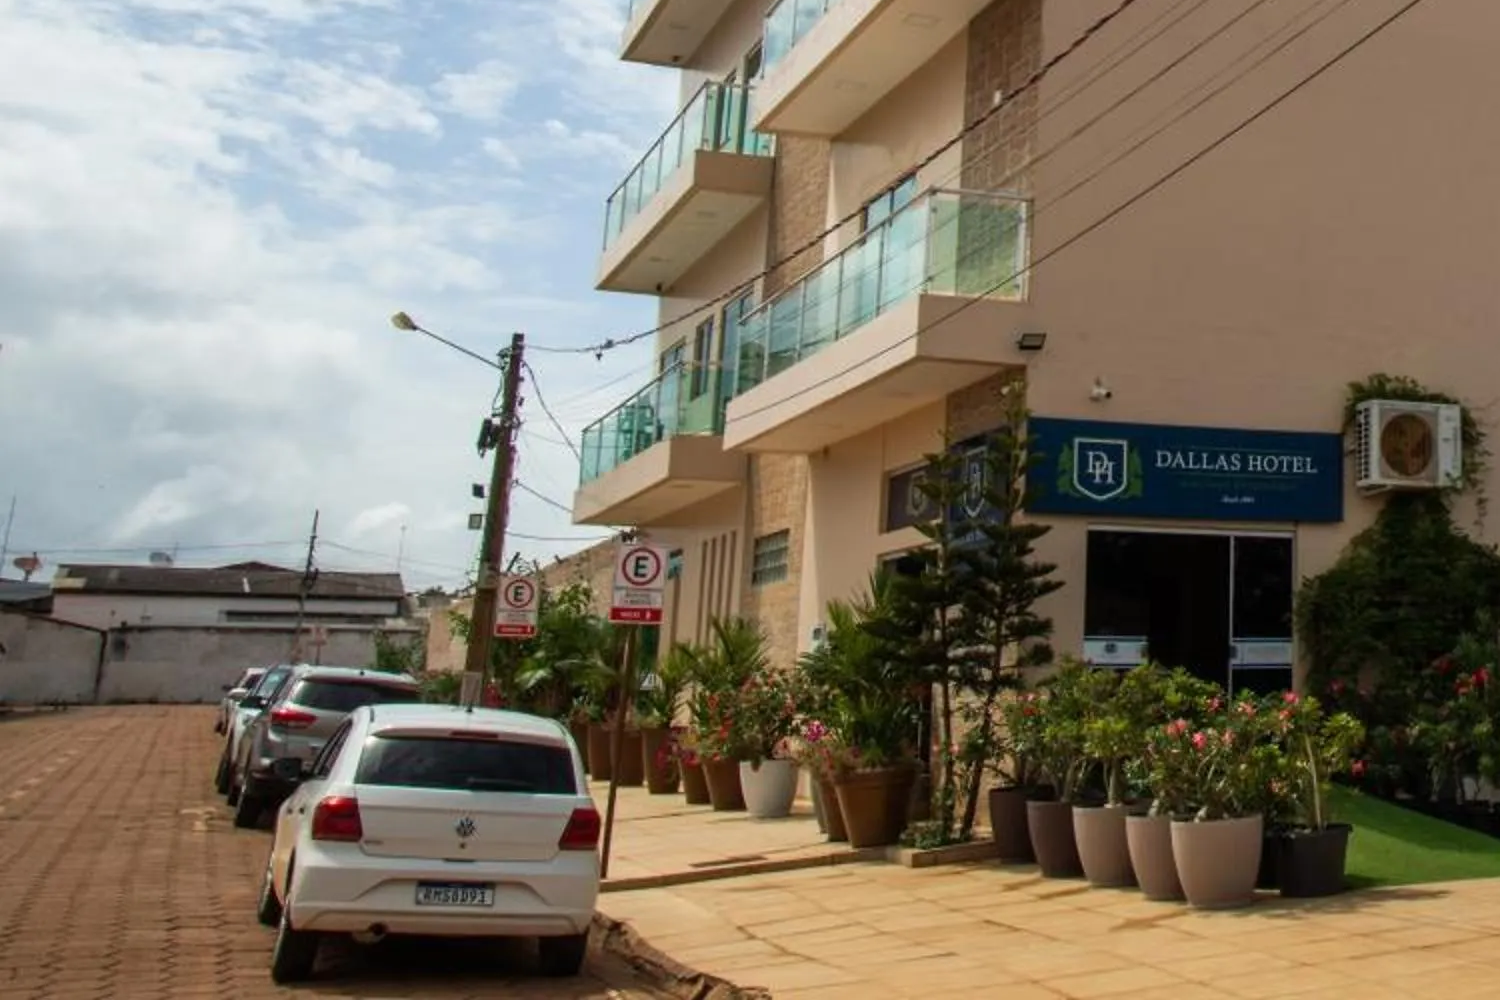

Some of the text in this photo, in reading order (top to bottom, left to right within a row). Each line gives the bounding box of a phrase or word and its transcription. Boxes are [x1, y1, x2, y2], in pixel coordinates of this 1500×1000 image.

[1155, 450, 1318, 474] DALLAS HOTEL
[634, 556, 648, 578] E
[513, 585, 525, 602] E
